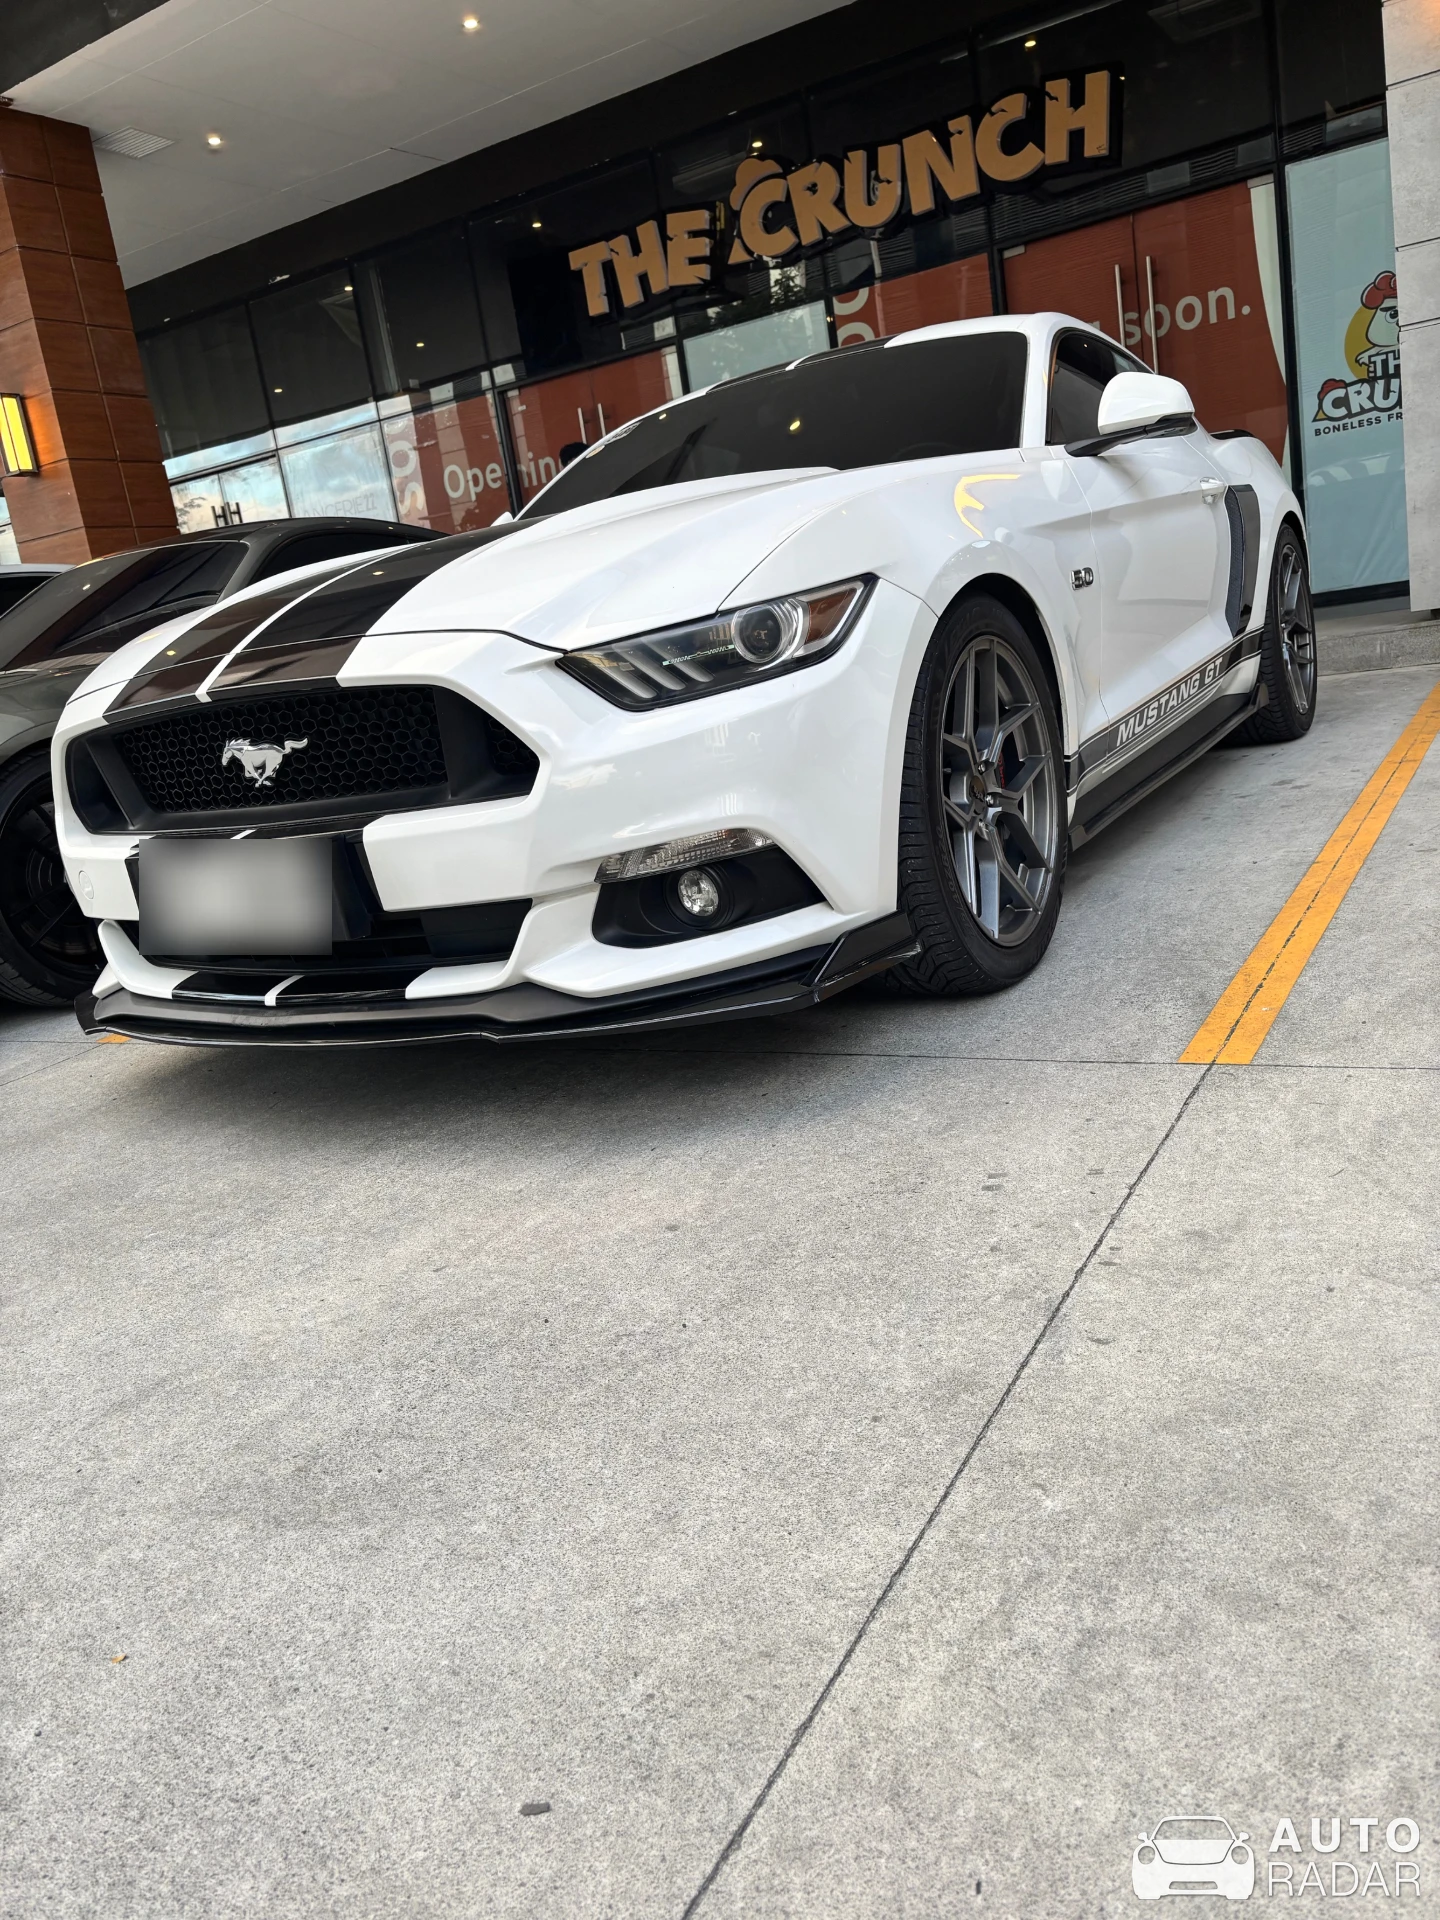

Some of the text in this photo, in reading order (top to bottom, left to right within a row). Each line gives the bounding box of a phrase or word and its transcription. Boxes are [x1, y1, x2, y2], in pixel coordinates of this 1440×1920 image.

[569, 70, 1110, 317] THE CRUNCH
[1123, 286, 1251, 346] soon.
[1370, 352, 1401, 377] TH
[1322, 378, 1400, 418] CRU
[1314, 411, 1404, 437] BONELESS FR
[444, 451, 564, 502] Openin
[1116, 656, 1223, 747] MUSTANG GT
